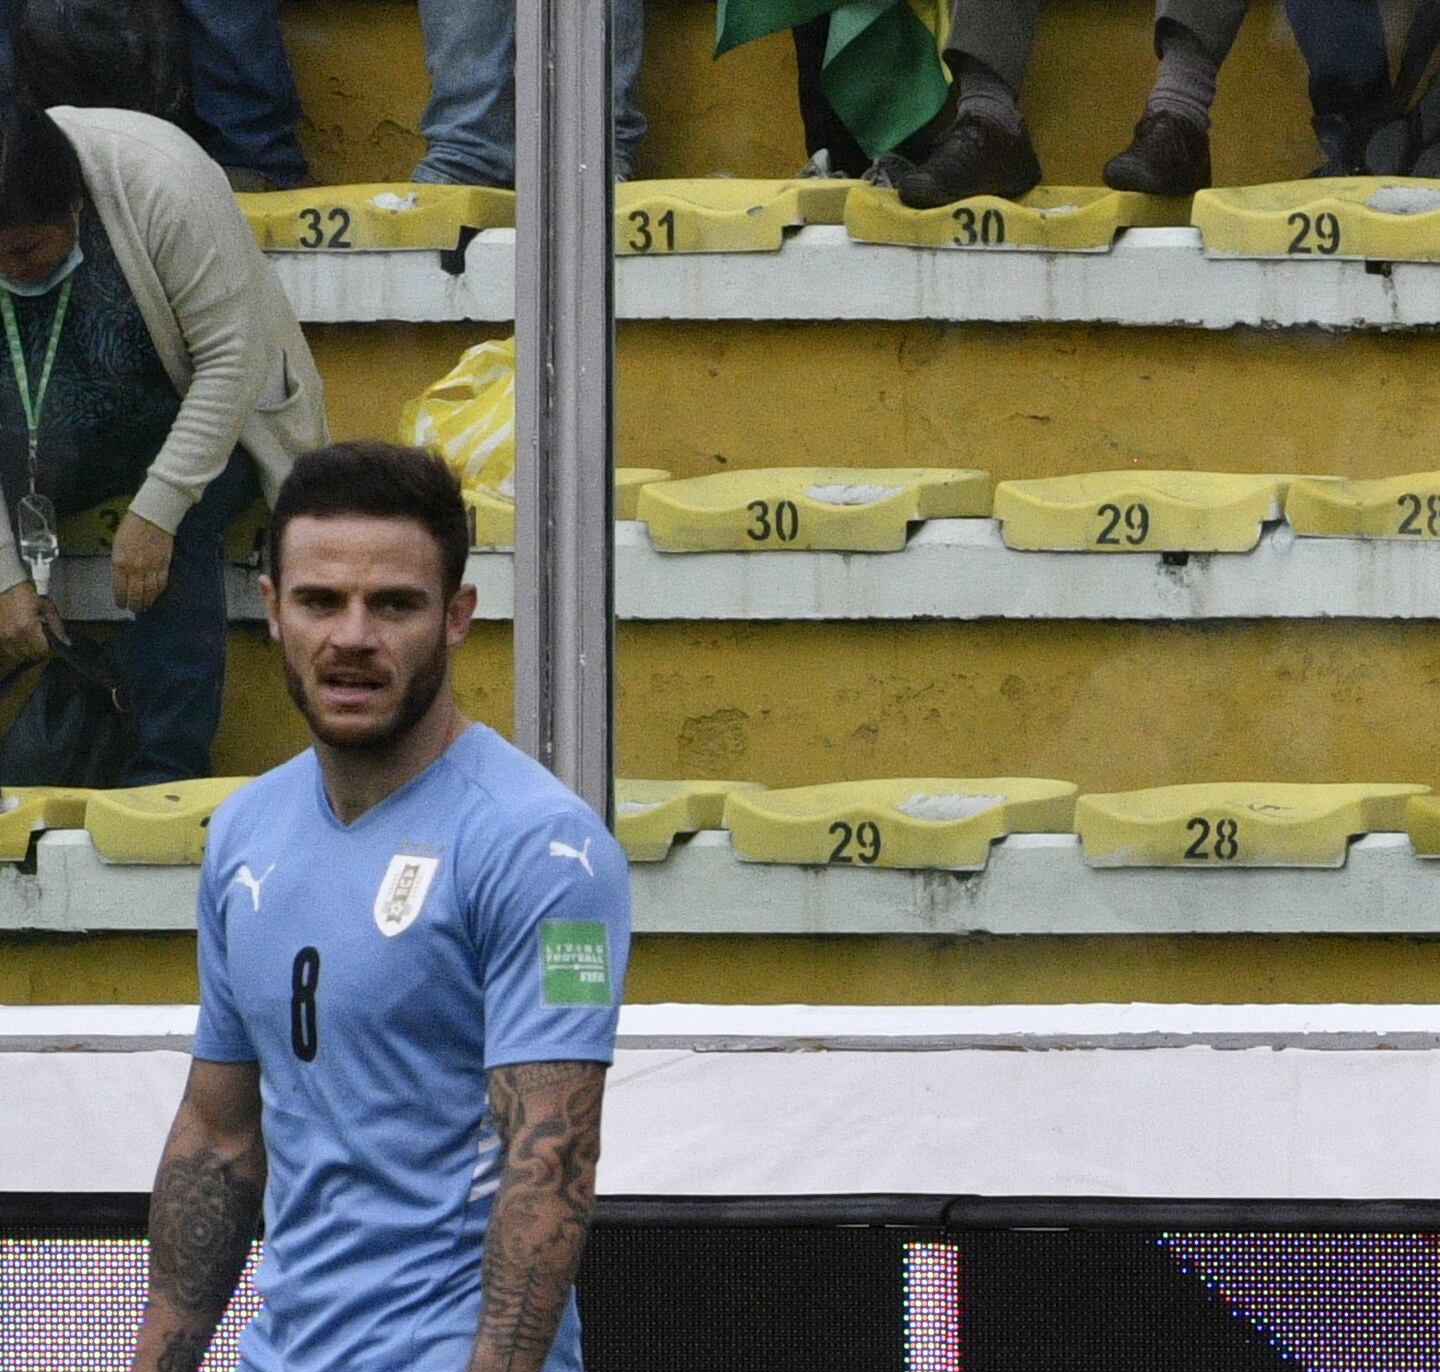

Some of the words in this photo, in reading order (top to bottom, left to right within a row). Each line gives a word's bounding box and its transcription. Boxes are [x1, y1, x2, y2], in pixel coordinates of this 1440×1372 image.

[299, 207, 351, 248] 32
[628, 210, 676, 251] 31
[952, 208, 1005, 246] 30
[1288, 213, 1340, 255] 29
[747, 501, 798, 542] 30
[1096, 504, 1149, 545] 29
[830, 822, 881, 864] 29
[1185, 818, 1238, 860] 28
[290, 945, 320, 1062] 8
